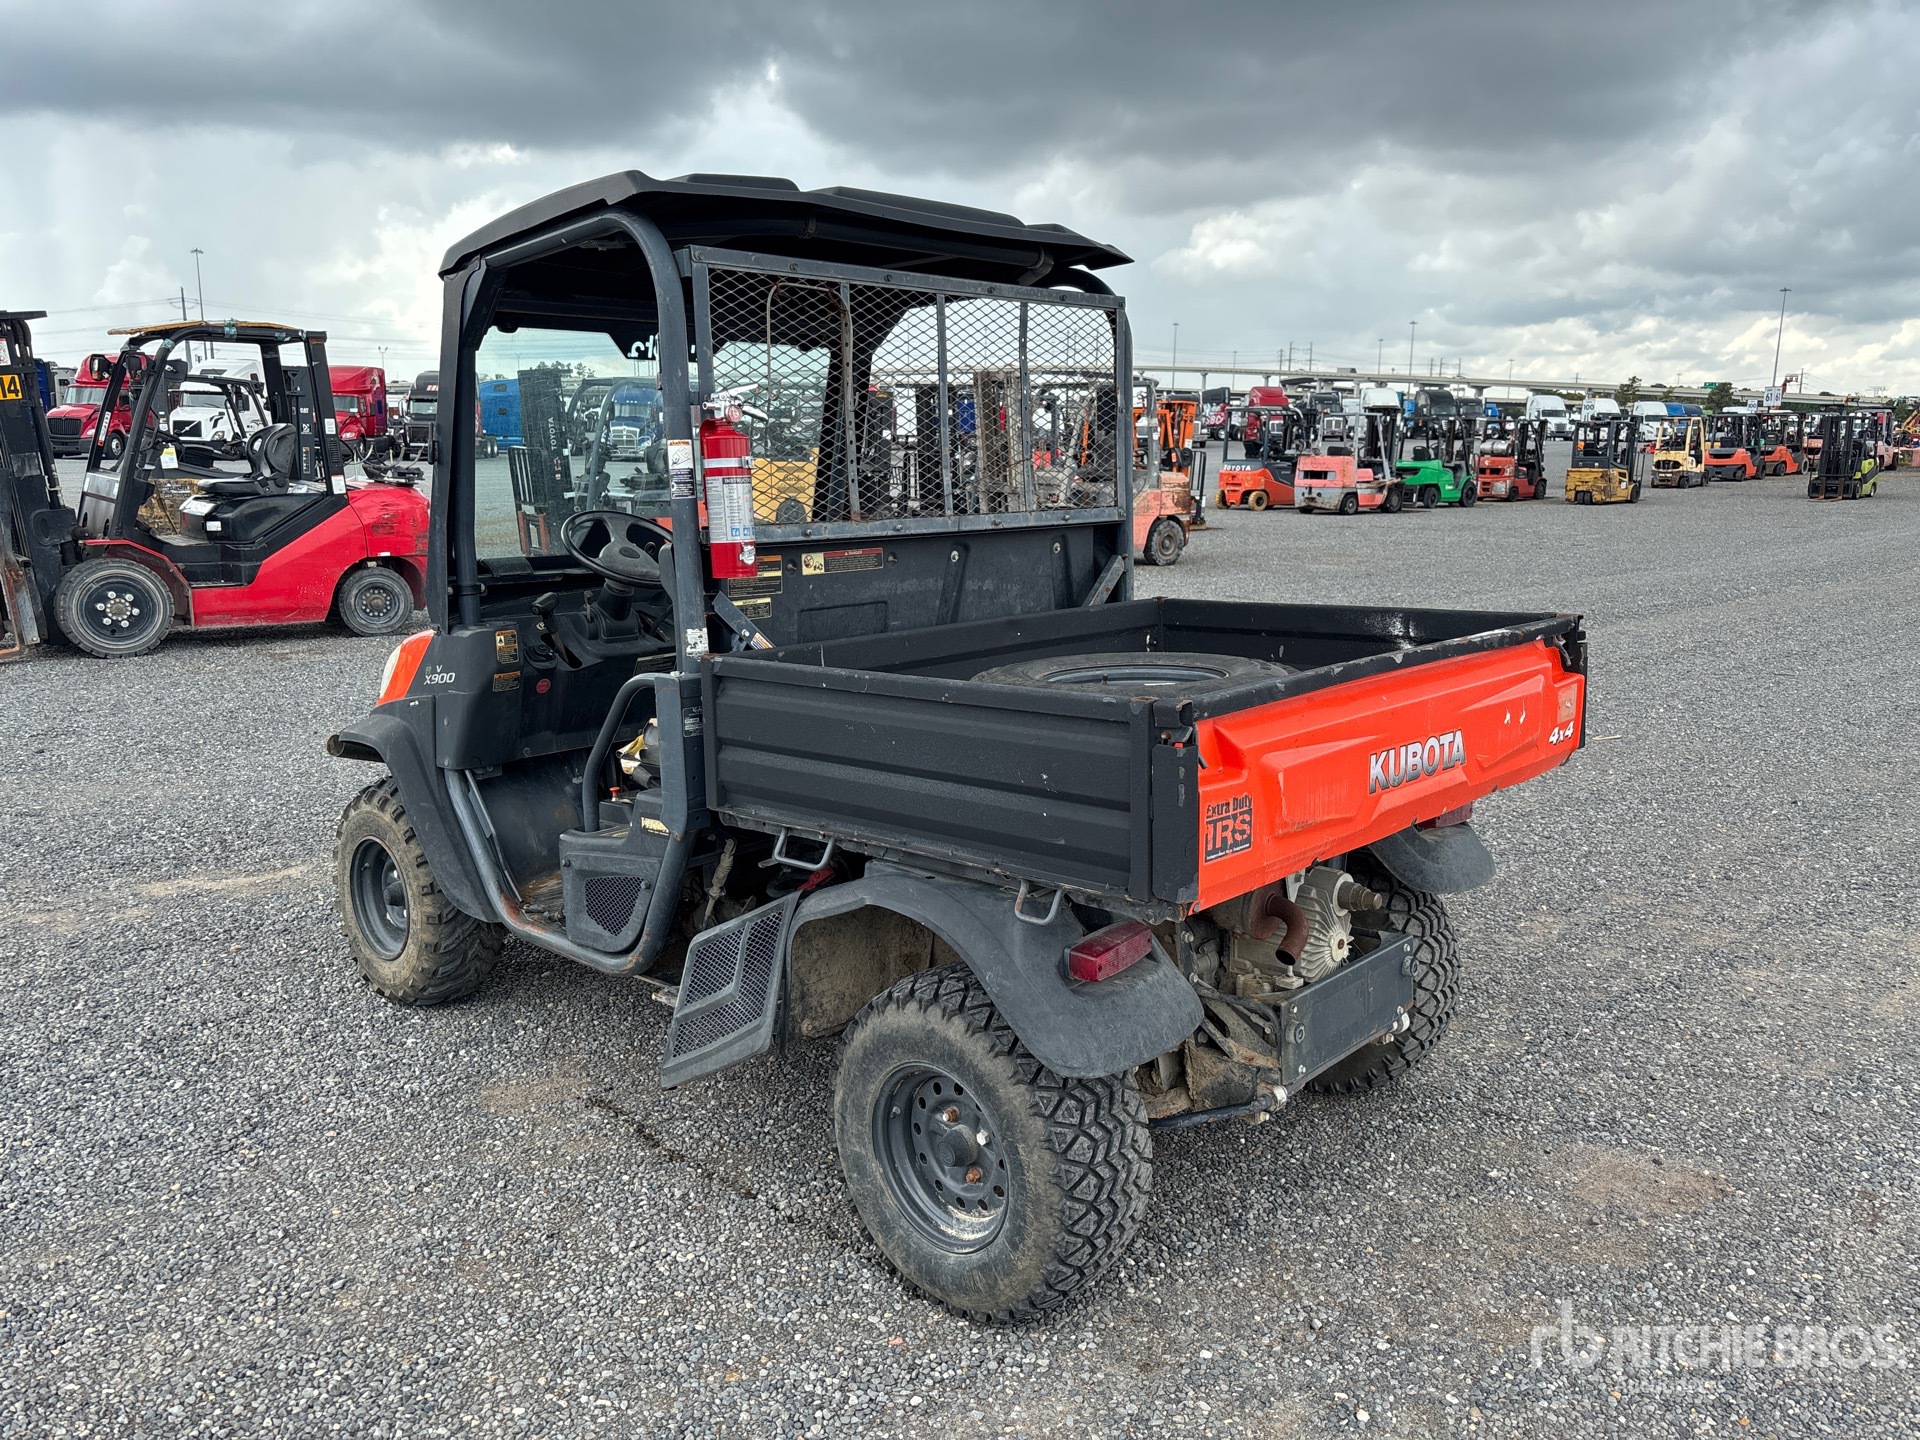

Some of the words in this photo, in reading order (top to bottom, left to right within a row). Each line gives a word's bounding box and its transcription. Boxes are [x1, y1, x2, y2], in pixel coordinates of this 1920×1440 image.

[1765, 393, 1773, 401] 61
[548, 416, 557, 451] TOYOTA
[424, 672, 455, 685] X900
[1548, 720, 1574, 745] 4x4
[1369, 729, 1466, 794] KUBOTA
[1206, 802, 1230, 819] Extra
[1233, 795, 1252, 811] Duty
[1207, 814, 1251, 851] IRS
